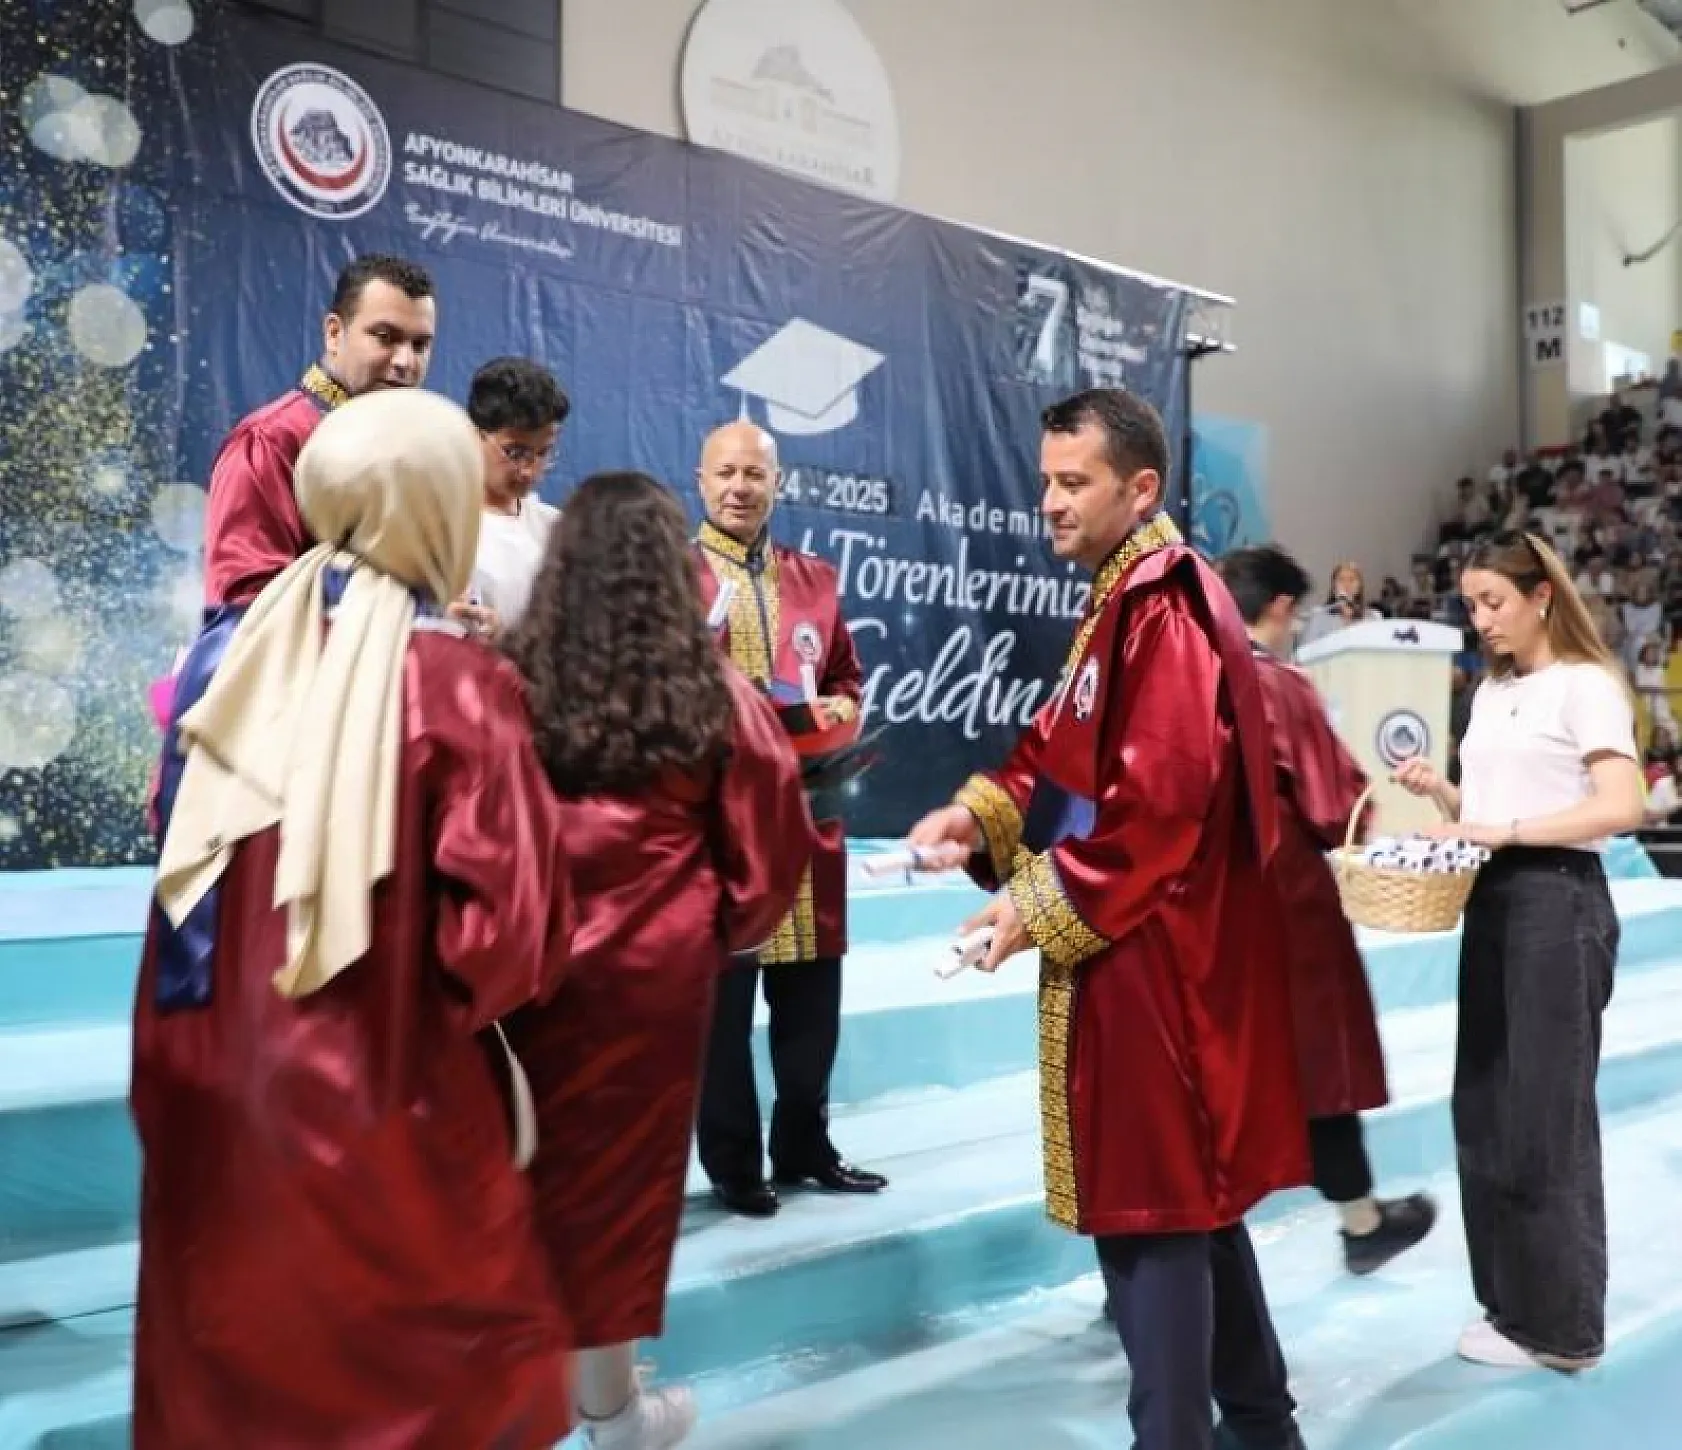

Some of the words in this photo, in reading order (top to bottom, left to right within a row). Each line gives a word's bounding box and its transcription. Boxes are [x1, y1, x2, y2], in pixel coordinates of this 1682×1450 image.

[403, 131, 574, 193] AFYONKARAHİSAR
[403, 160, 474, 196] SAĞLIK
[1528, 306, 1564, 329] 112
[1535, 338, 1561, 361] M
[825, 474, 888, 513] 2025
[828, 528, 1093, 618] Törenlerimiz
